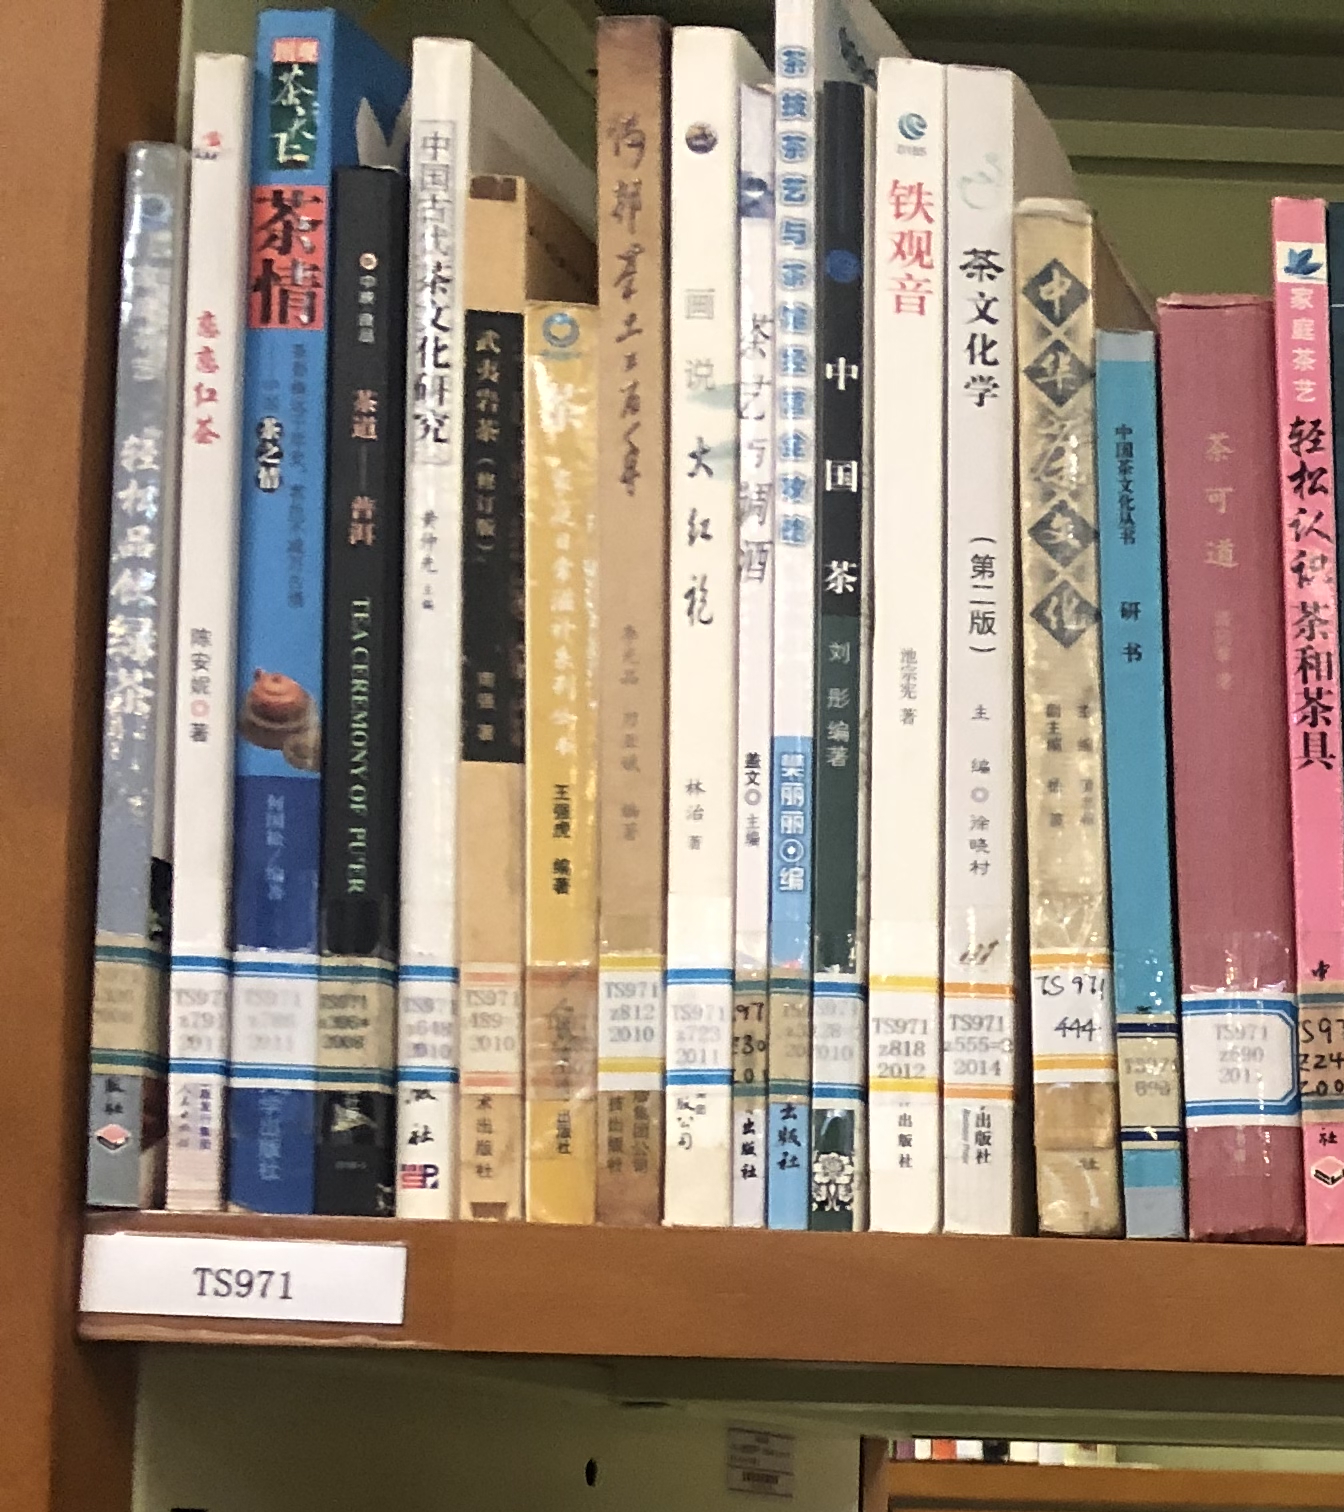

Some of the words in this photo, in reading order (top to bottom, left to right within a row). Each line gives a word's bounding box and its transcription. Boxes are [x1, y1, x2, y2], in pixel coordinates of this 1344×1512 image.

[252, 187, 323, 326] 茶情
[887, 179, 935, 317] 铁观音
[959, 247, 1004, 409] 茶文化学
[1290, 286, 1317, 403] 家庭茶艺
[825, 356, 859, 595] 中国茶
[1114, 424, 1136, 546] 中国茶文化丛书
[1203, 431, 1239, 569] 茶可道
[1286, 416, 1337, 771] 轻松认识茶和茶具
[347, 648, 371, 775] CEREMONY
[872, 1017, 929, 1036] TS971
[949, 1013, 1006, 1032] TS971
[194, 1266, 294, 1301] TS971
